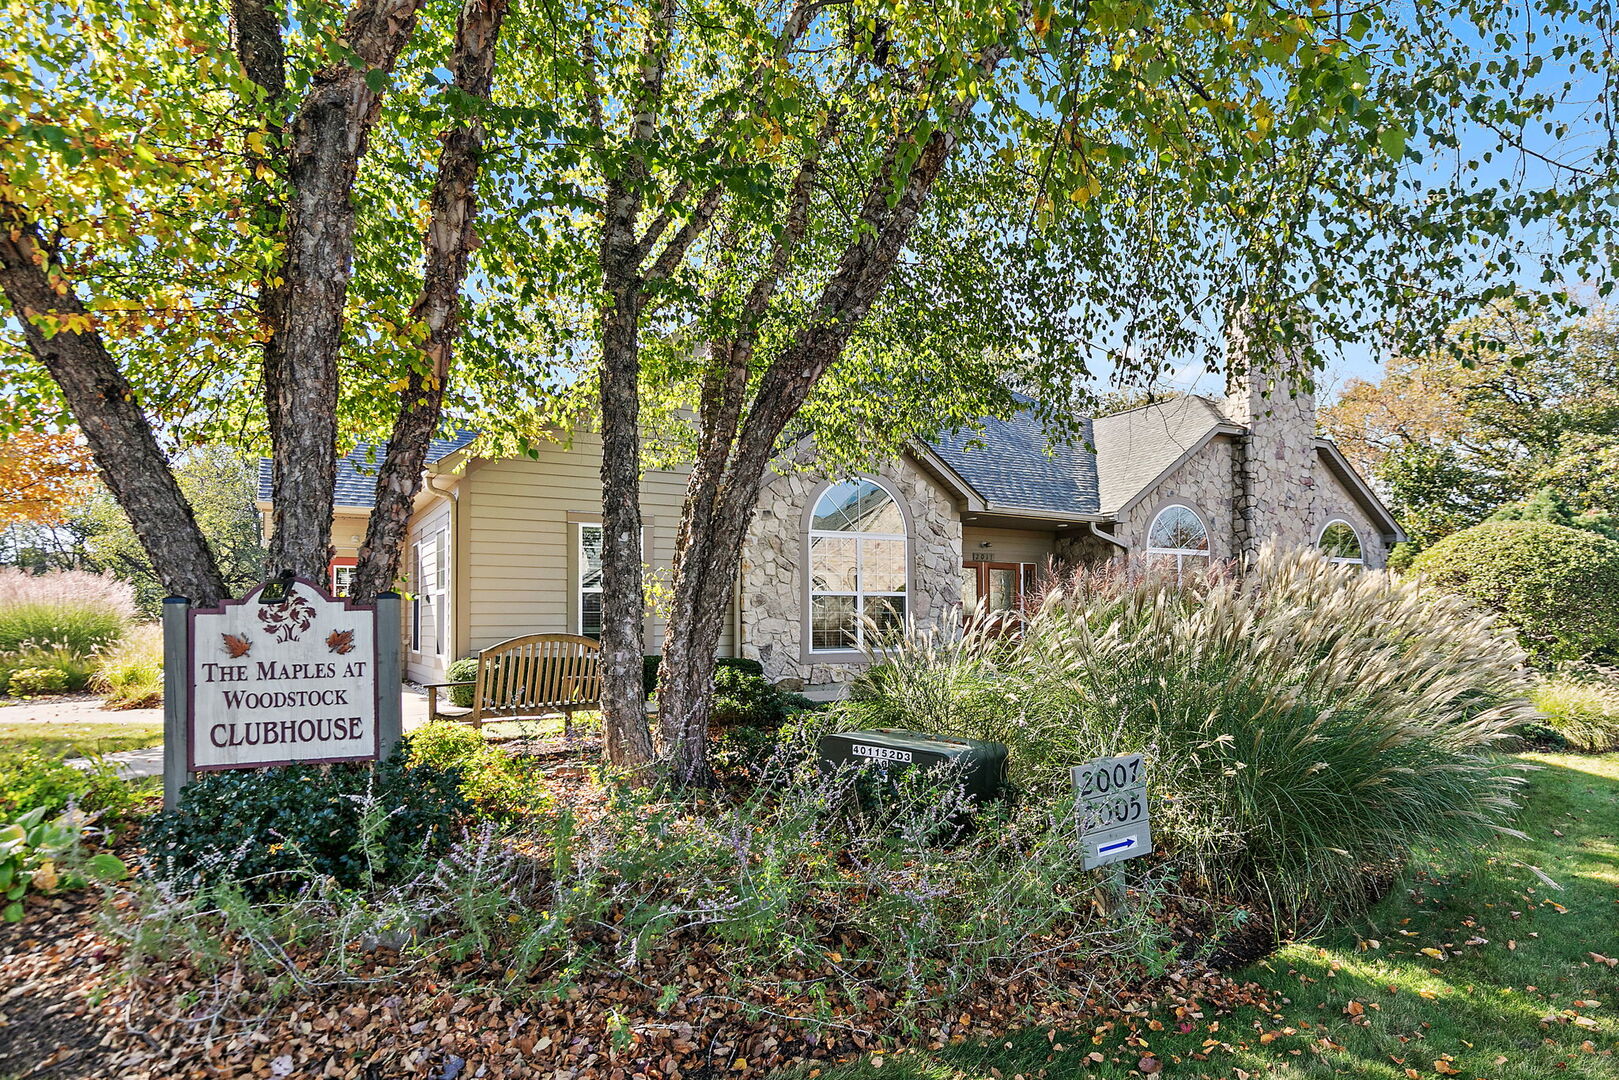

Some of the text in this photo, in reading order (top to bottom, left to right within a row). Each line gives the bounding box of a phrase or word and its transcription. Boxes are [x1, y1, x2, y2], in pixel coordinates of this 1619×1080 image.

[202, 661, 366, 682] THE MAPLES AT
[222, 690, 348, 709] WOODSTOCK
[210, 717, 363, 748] CLUBHOUSE
[853, 746, 911, 761] 401152D3
[1081, 758, 1140, 798] 2007
[1084, 794, 1141, 830] 2005
